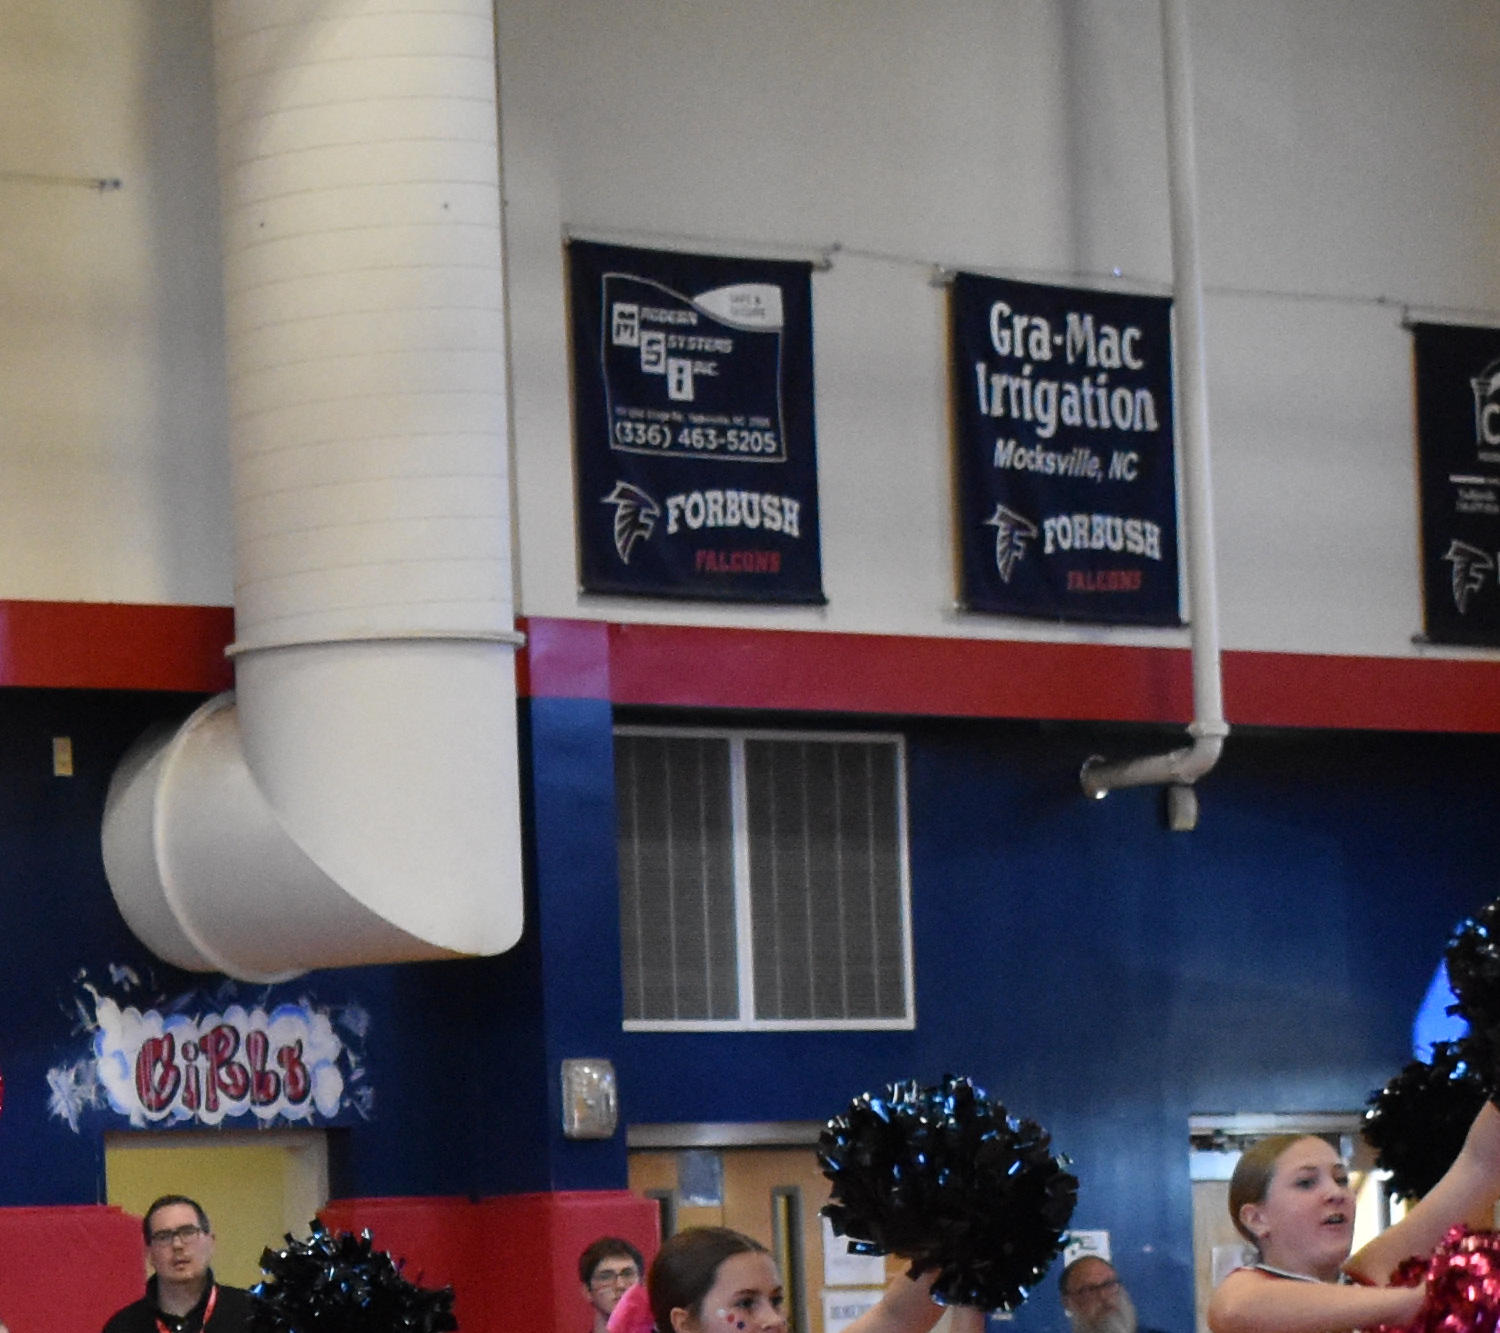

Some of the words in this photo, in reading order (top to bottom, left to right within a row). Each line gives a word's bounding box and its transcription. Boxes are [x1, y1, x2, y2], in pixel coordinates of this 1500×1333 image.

[989, 300, 1144, 371] Gra-Mac
[975, 361, 1160, 439] Irrigation
[615, 421, 671, 449] (336)
[677, 426, 777, 453] 463-5205
[993, 438, 1102, 483] Mocksville,
[1108, 450, 1138, 483] NC
[665, 489, 800, 538] FORBUSH
[1043, 513, 1163, 562] FORBUSH
